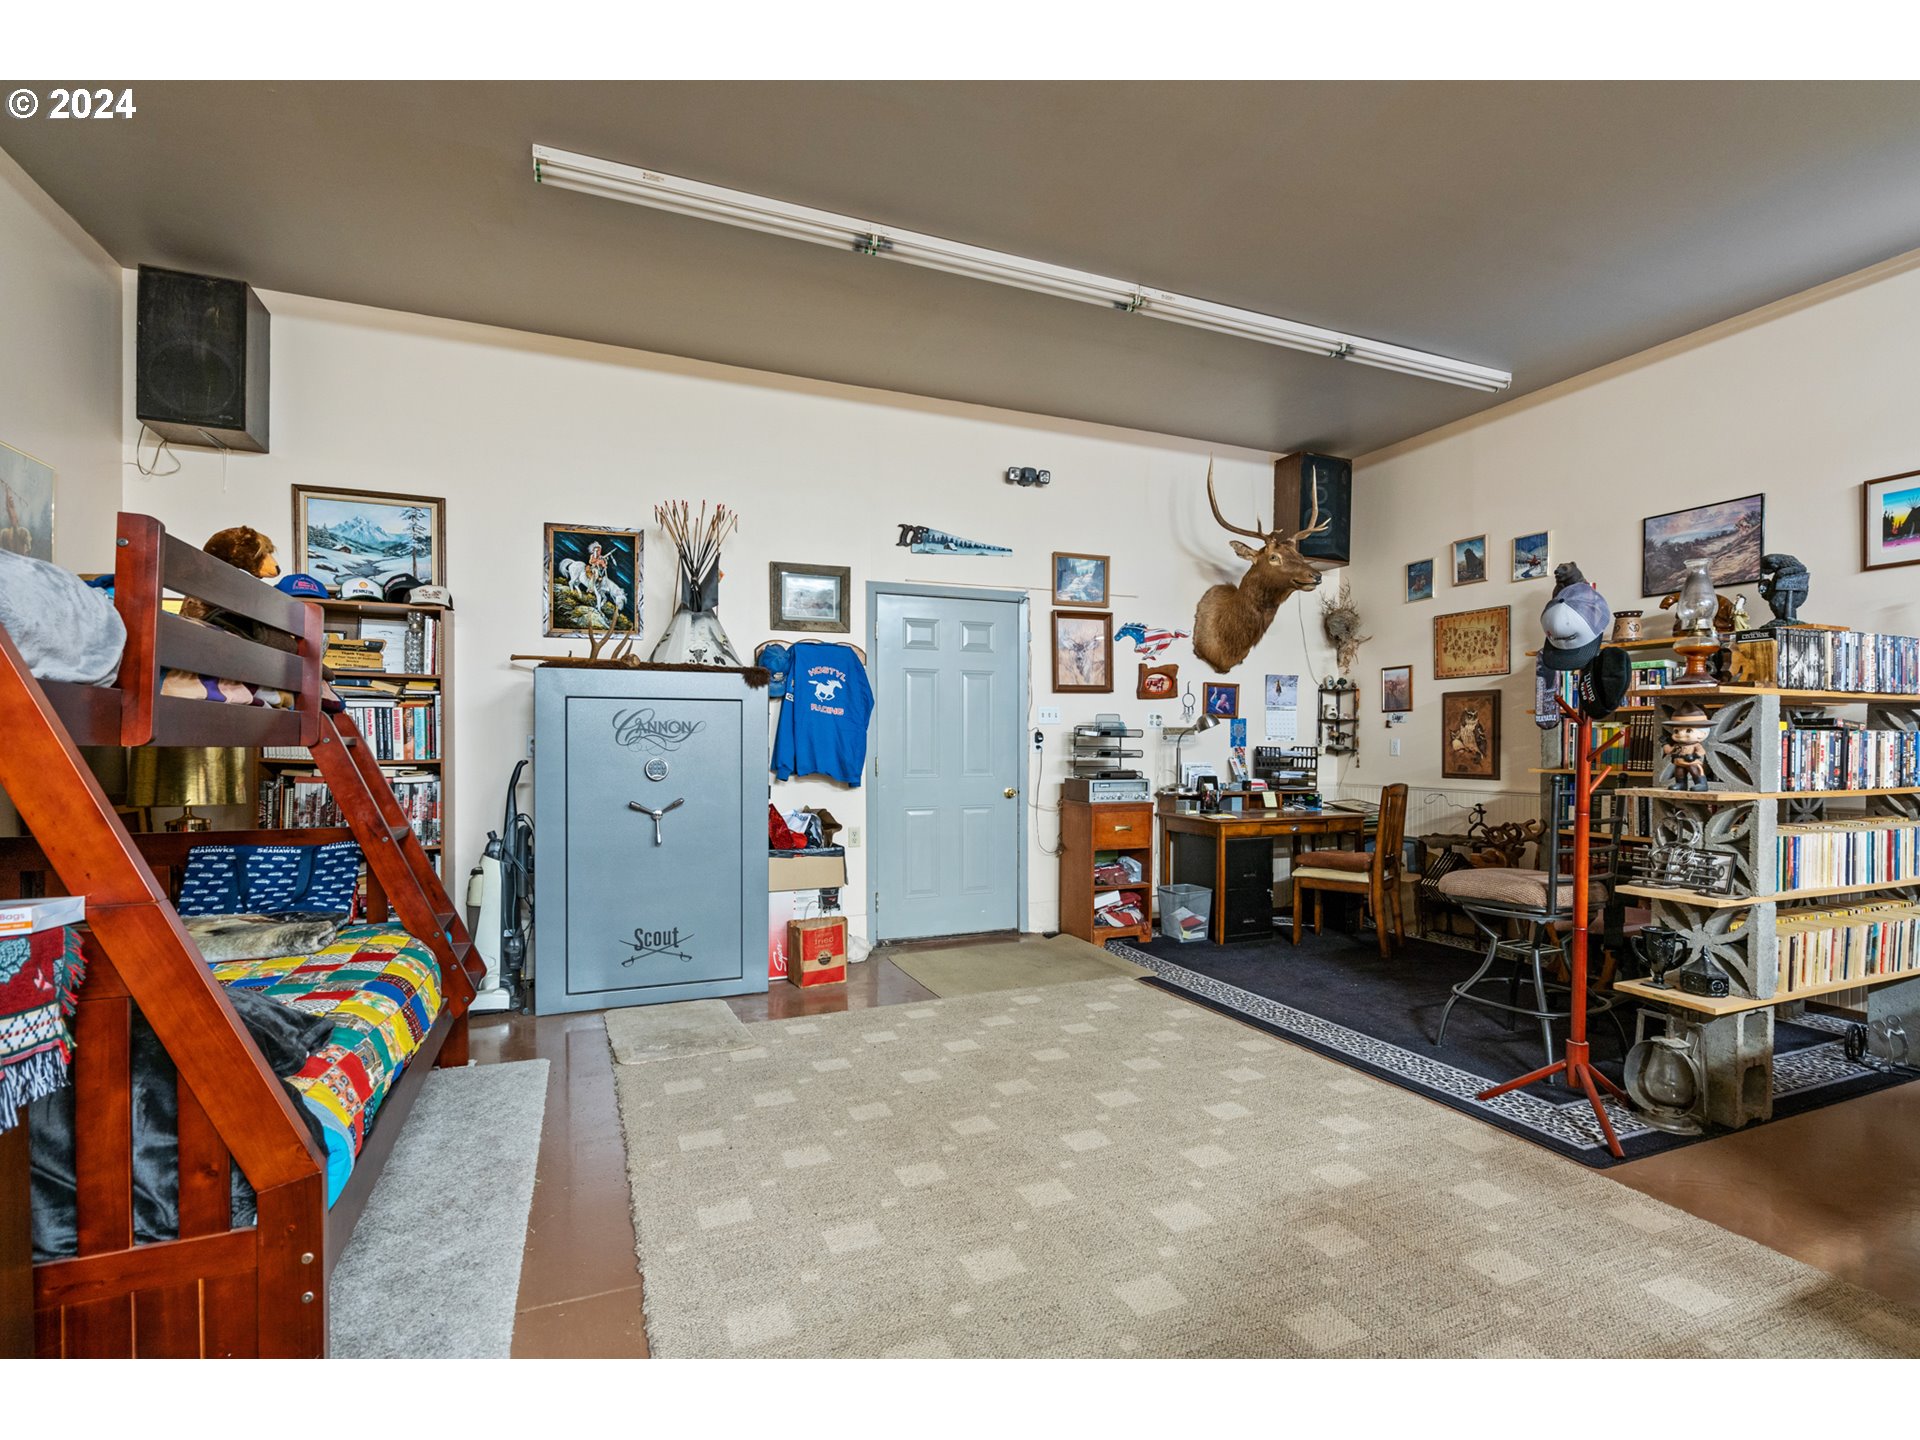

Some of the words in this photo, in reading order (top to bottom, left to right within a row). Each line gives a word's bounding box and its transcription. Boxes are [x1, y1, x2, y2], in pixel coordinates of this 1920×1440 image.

[810, 703, 844, 716] RACING
[612, 708, 706, 756] CANNON
[634, 927, 679, 951] Scout
[773, 939, 788, 973] Super
